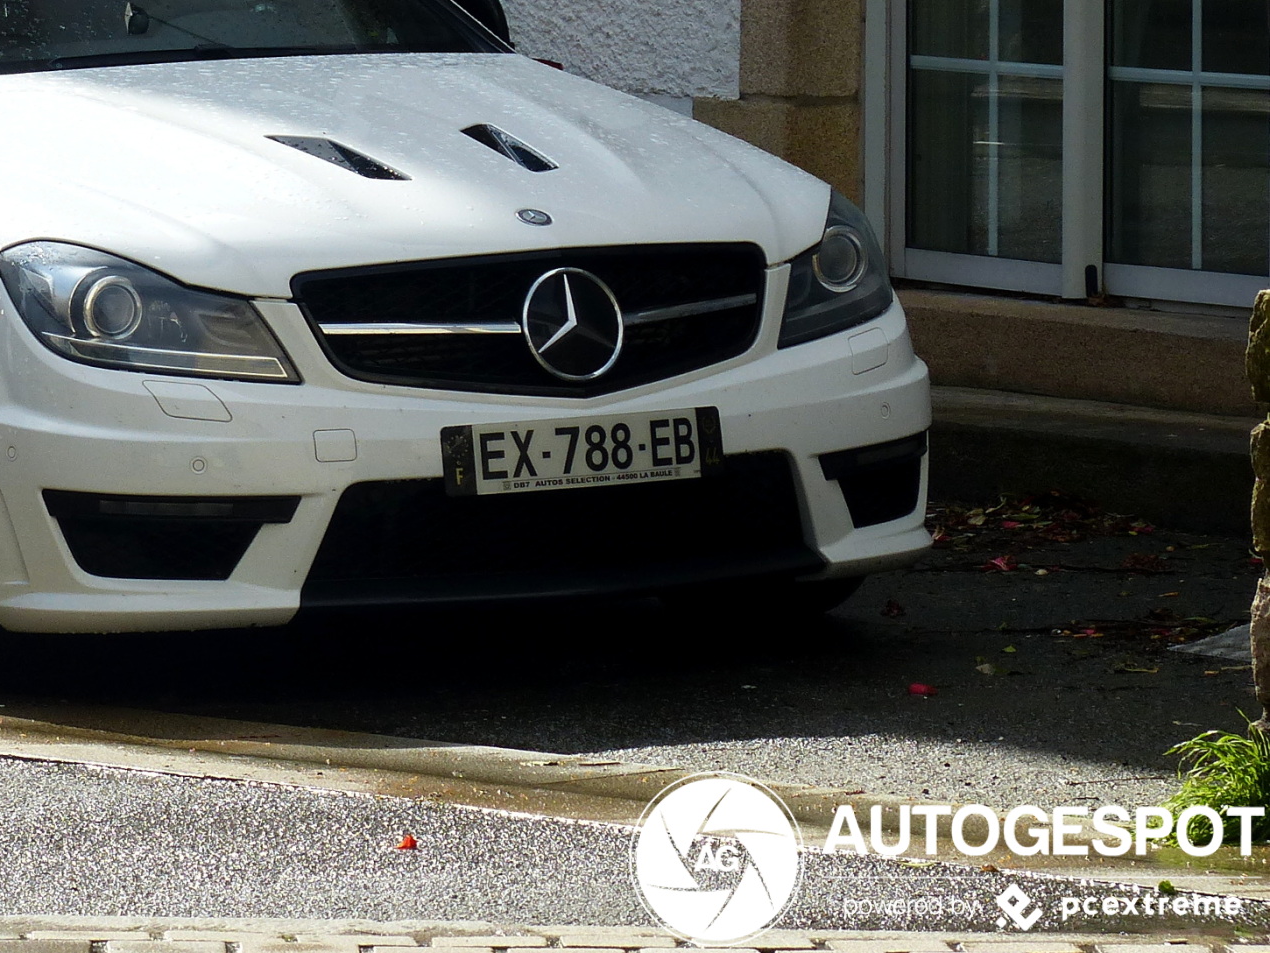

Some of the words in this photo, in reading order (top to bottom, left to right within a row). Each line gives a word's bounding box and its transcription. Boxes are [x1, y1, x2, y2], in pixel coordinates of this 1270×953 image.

[454, 467, 465, 486] F
[513, 481, 530, 489] DB7
[534, 479, 564, 488] AUTOS
[565, 475, 611, 486] SELECTION
[616, 470, 638, 480] 44500
[639, 470, 649, 479] LA
[650, 469, 673, 478] BAULE
